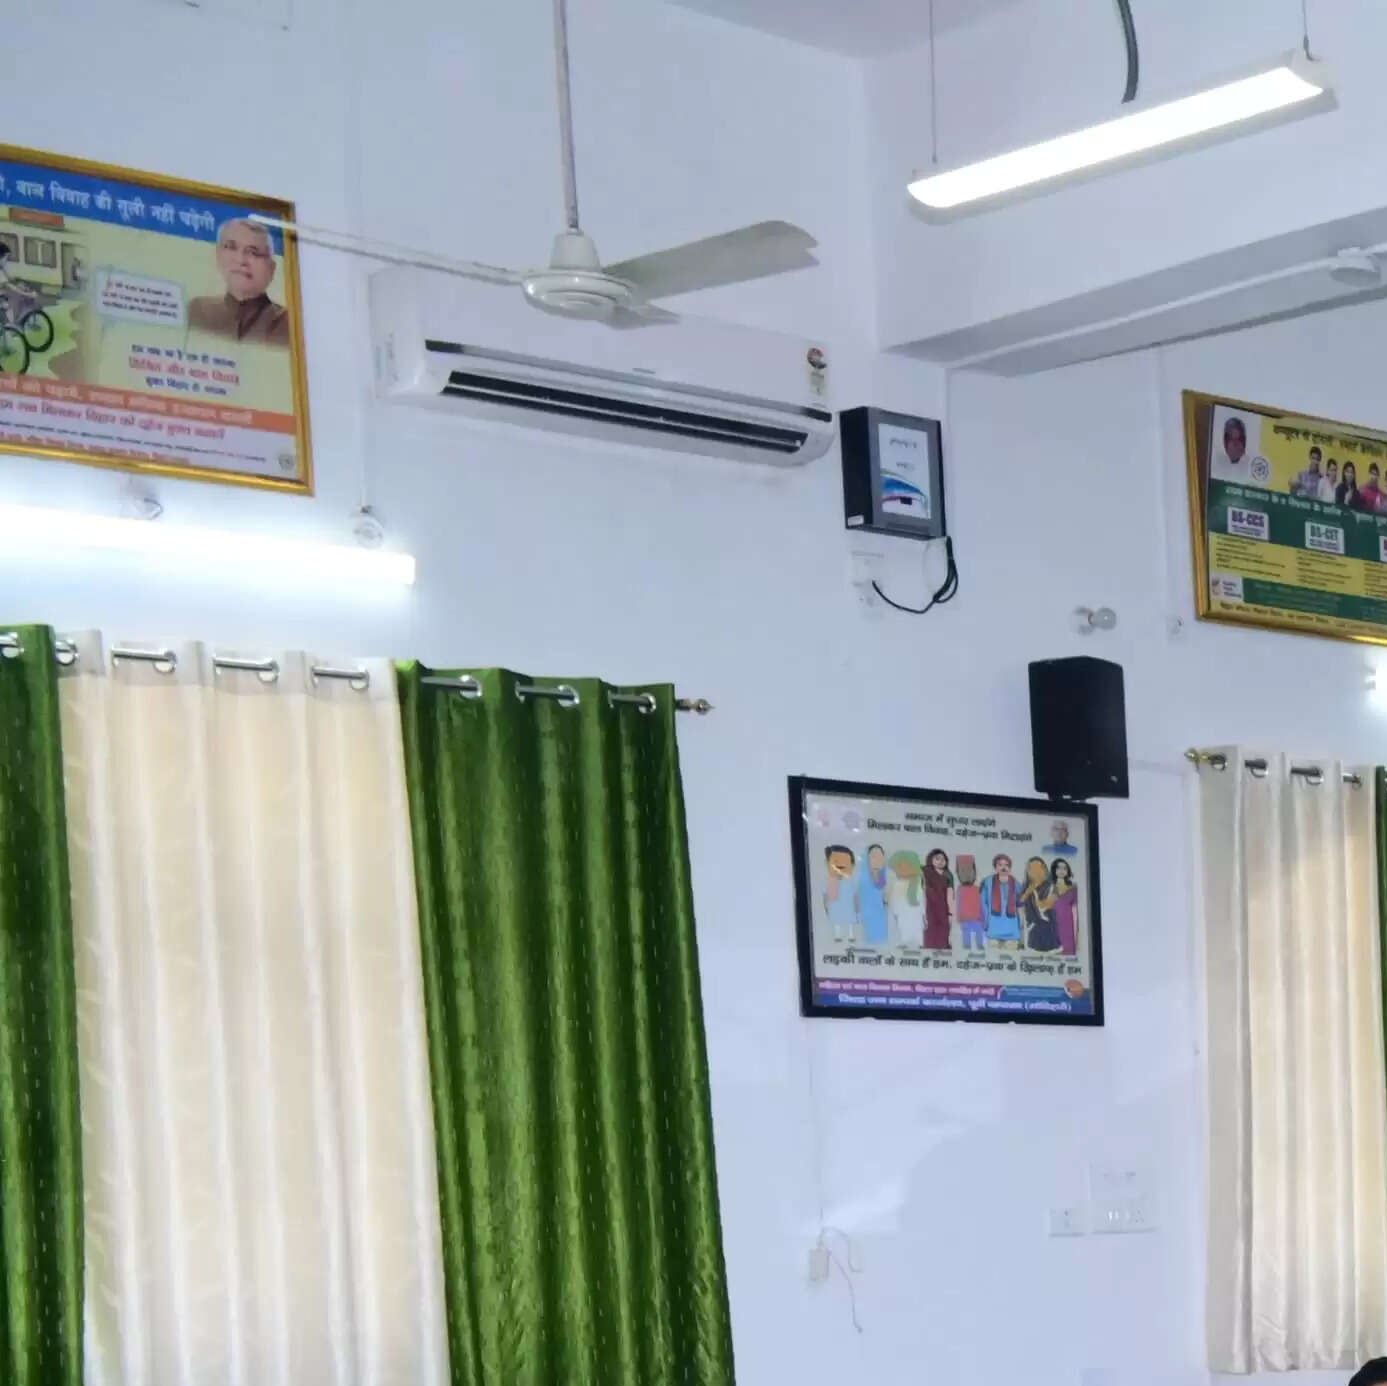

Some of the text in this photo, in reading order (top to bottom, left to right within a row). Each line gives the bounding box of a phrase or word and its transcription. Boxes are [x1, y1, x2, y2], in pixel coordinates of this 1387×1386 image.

[50, 180, 90, 208] विवाह
[94, 189, 112, 210] की
[151, 202, 175, 224] नहीं
